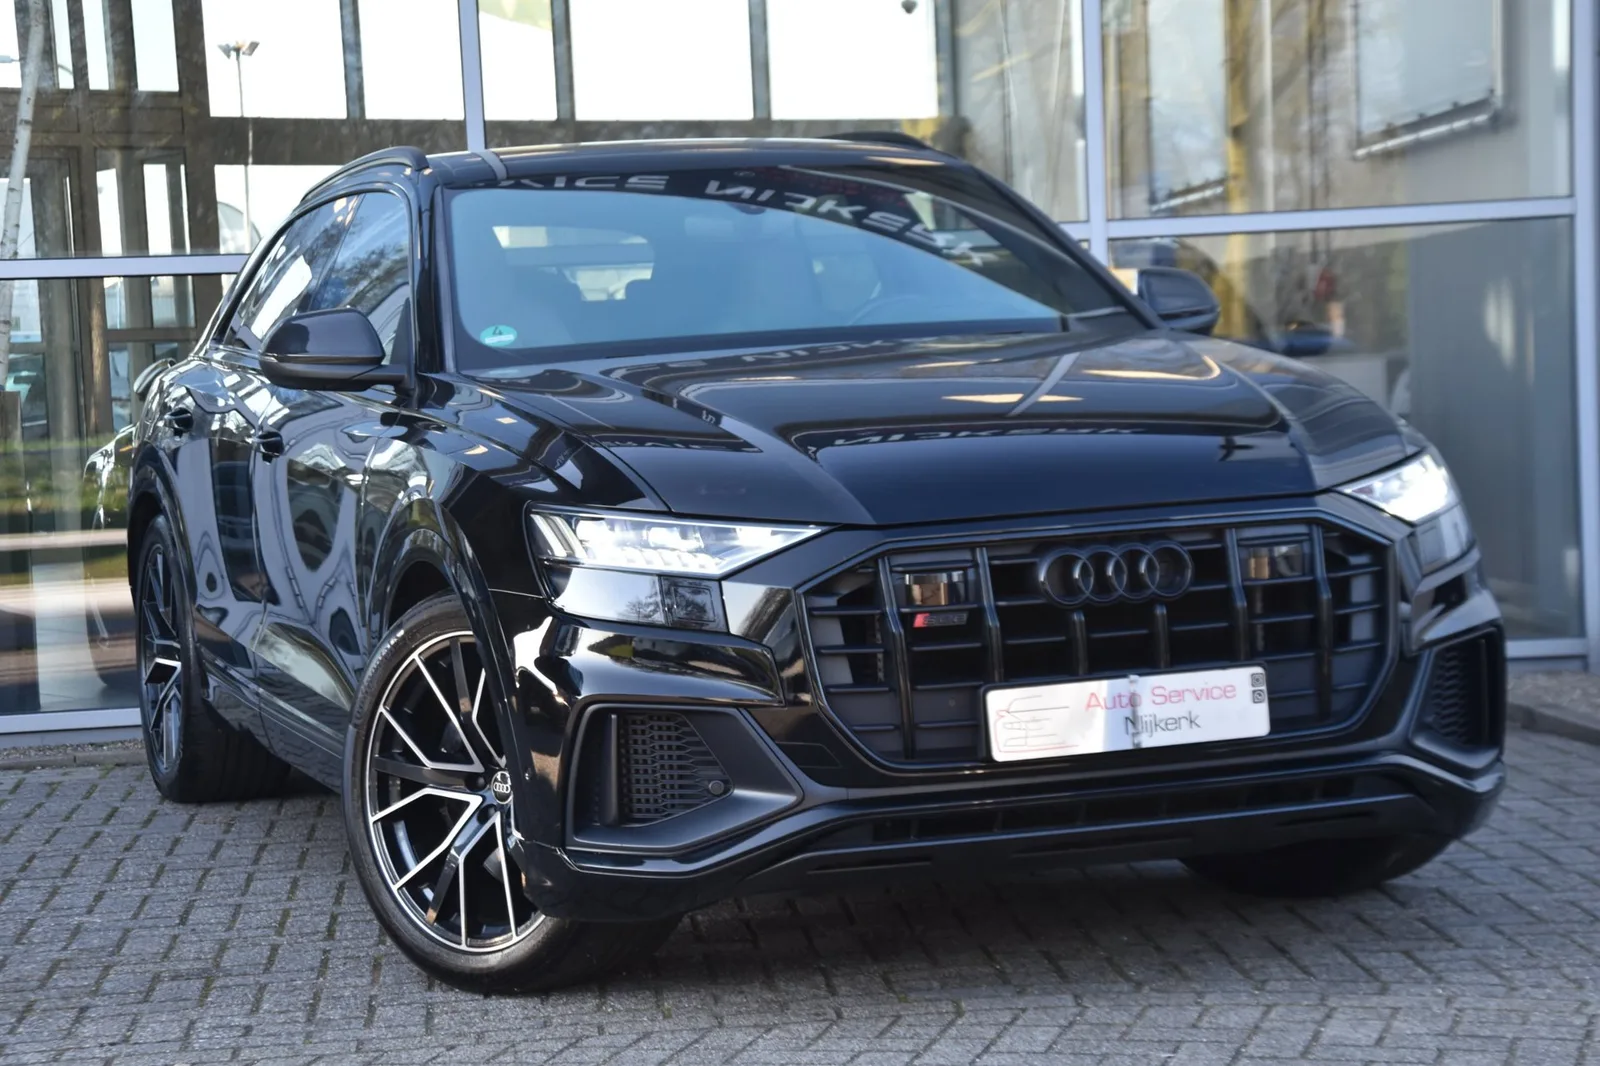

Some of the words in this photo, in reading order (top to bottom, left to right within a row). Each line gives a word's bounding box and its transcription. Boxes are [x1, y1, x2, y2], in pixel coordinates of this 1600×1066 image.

[1085, 692, 1142, 711] Auto
[1151, 684, 1236, 705] Service
[1124, 711, 1201, 737] Nijkerk
